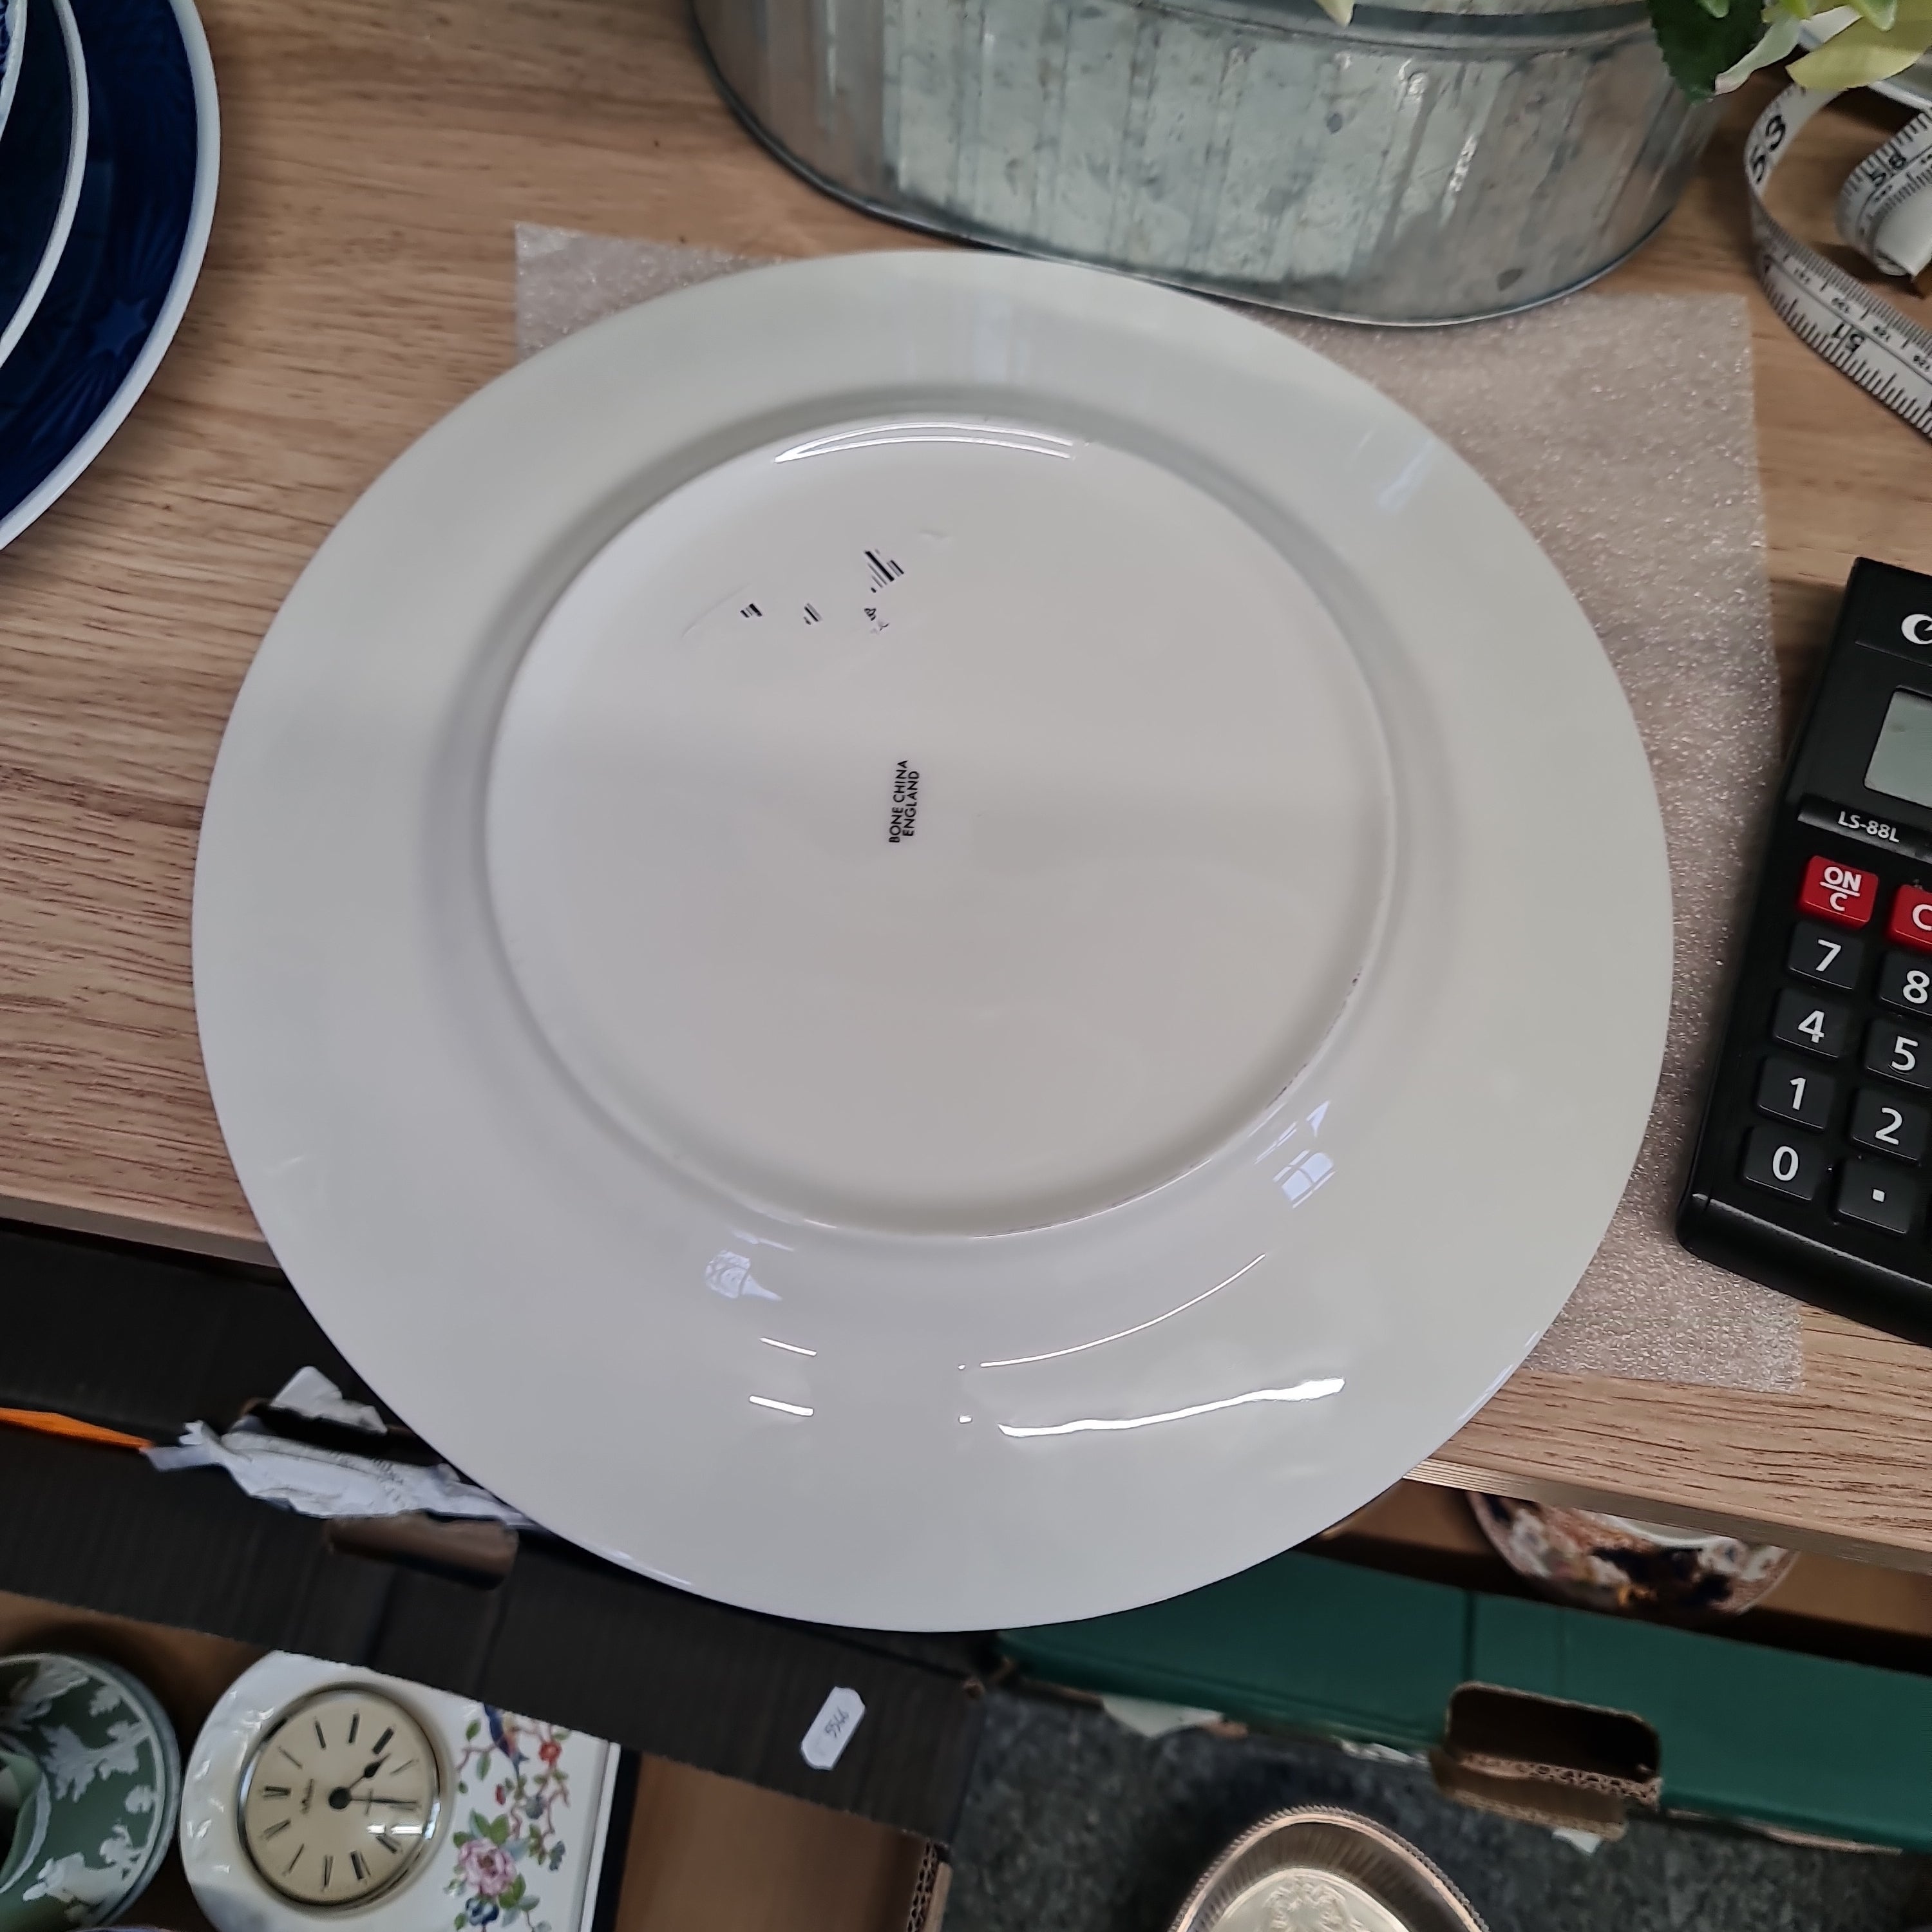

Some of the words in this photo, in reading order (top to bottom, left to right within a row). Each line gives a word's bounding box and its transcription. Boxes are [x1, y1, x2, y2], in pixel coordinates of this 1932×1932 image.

[1750, 115, 1786, 184] 53
[1869, 153, 1907, 187] 58
[1831, 323, 1865, 353] 51
[893, 760, 909, 803] CHINA
[902, 771, 920, 837] ENGLAND
[888, 807, 904, 843] BONE
[1837, 811, 1900, 843] LS-88L
[1823, 866, 1862, 892] ON
[1830, 892, 1848, 912] C
[1912, 904, 1932, 931] C
[1815, 938, 1842, 972] 7
[1902, 970, 1931, 1005] 8
[1797, 1010, 1826, 1043] 4
[1891, 1036, 1919, 1072] 5
[1790, 1077, 1806, 1111] 1
[1875, 1106, 1903, 1146] 2
[1772, 1146, 1799, 1182] 0
